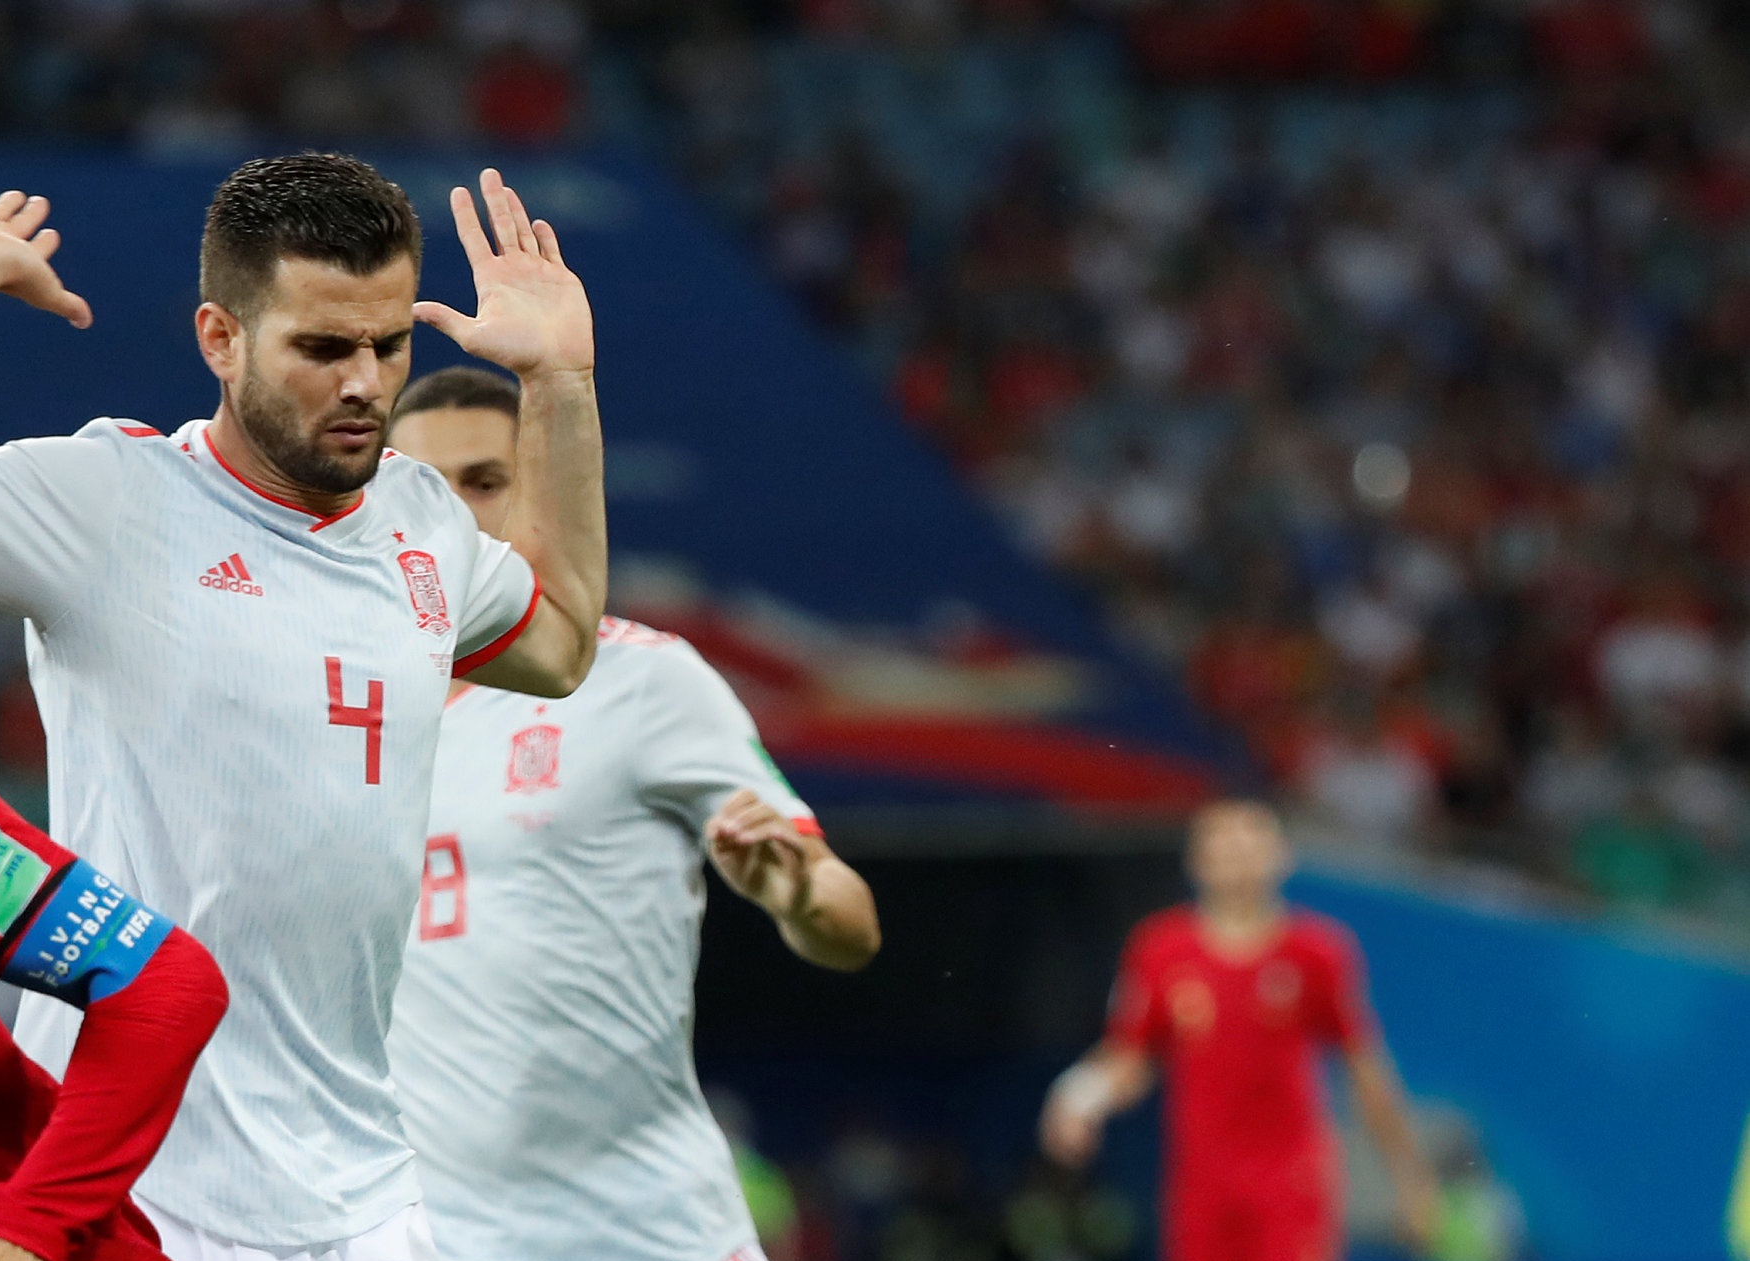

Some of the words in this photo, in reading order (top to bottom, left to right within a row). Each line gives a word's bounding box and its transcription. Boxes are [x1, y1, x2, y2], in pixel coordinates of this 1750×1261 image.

[198, 575, 264, 597] adidas
[324, 656, 384, 785] 4
[5, 853, 27, 879] FIFA
[419, 833, 467, 942] 8
[116, 907, 155, 950] FIFA
